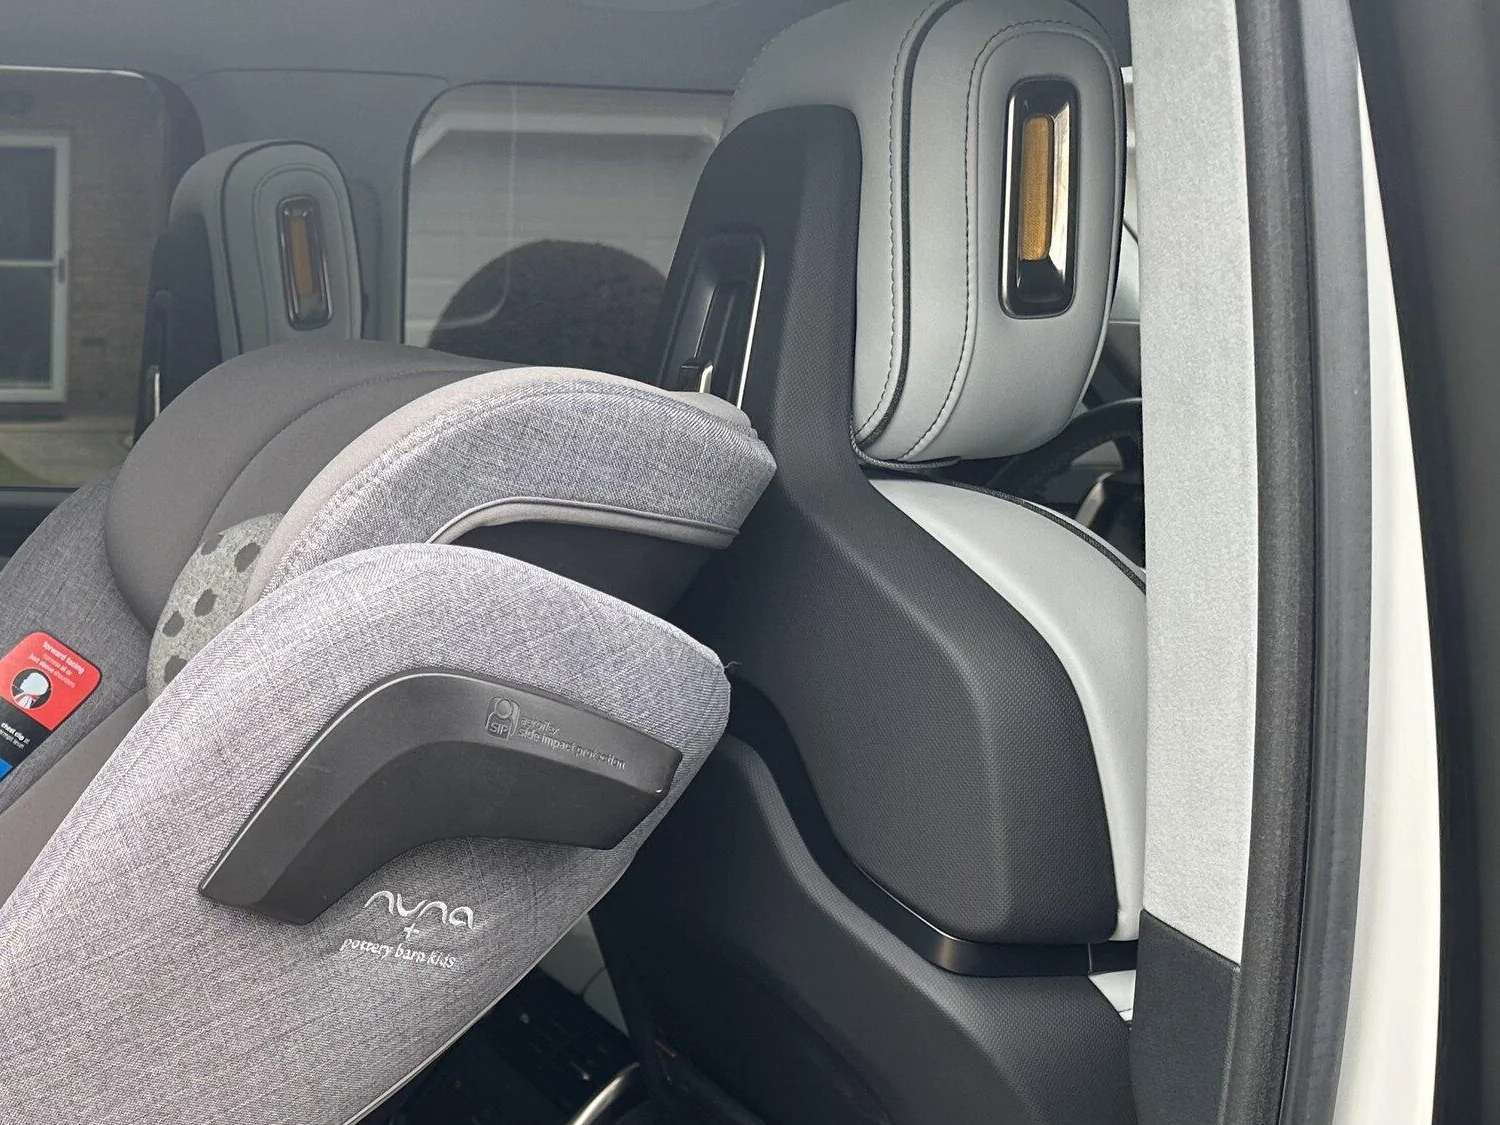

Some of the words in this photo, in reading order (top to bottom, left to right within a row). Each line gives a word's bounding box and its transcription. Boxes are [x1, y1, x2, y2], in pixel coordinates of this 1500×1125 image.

[41, 640, 67, 661] forward
[63, 656, 86, 675] facing
[489, 722, 508, 736] SIP
[519, 728, 540, 742] side
[541, 734, 575, 753] impact
[339, 938, 393, 960] pottery
[394, 943, 426, 962] barn
[427, 950, 456, 968] kids
